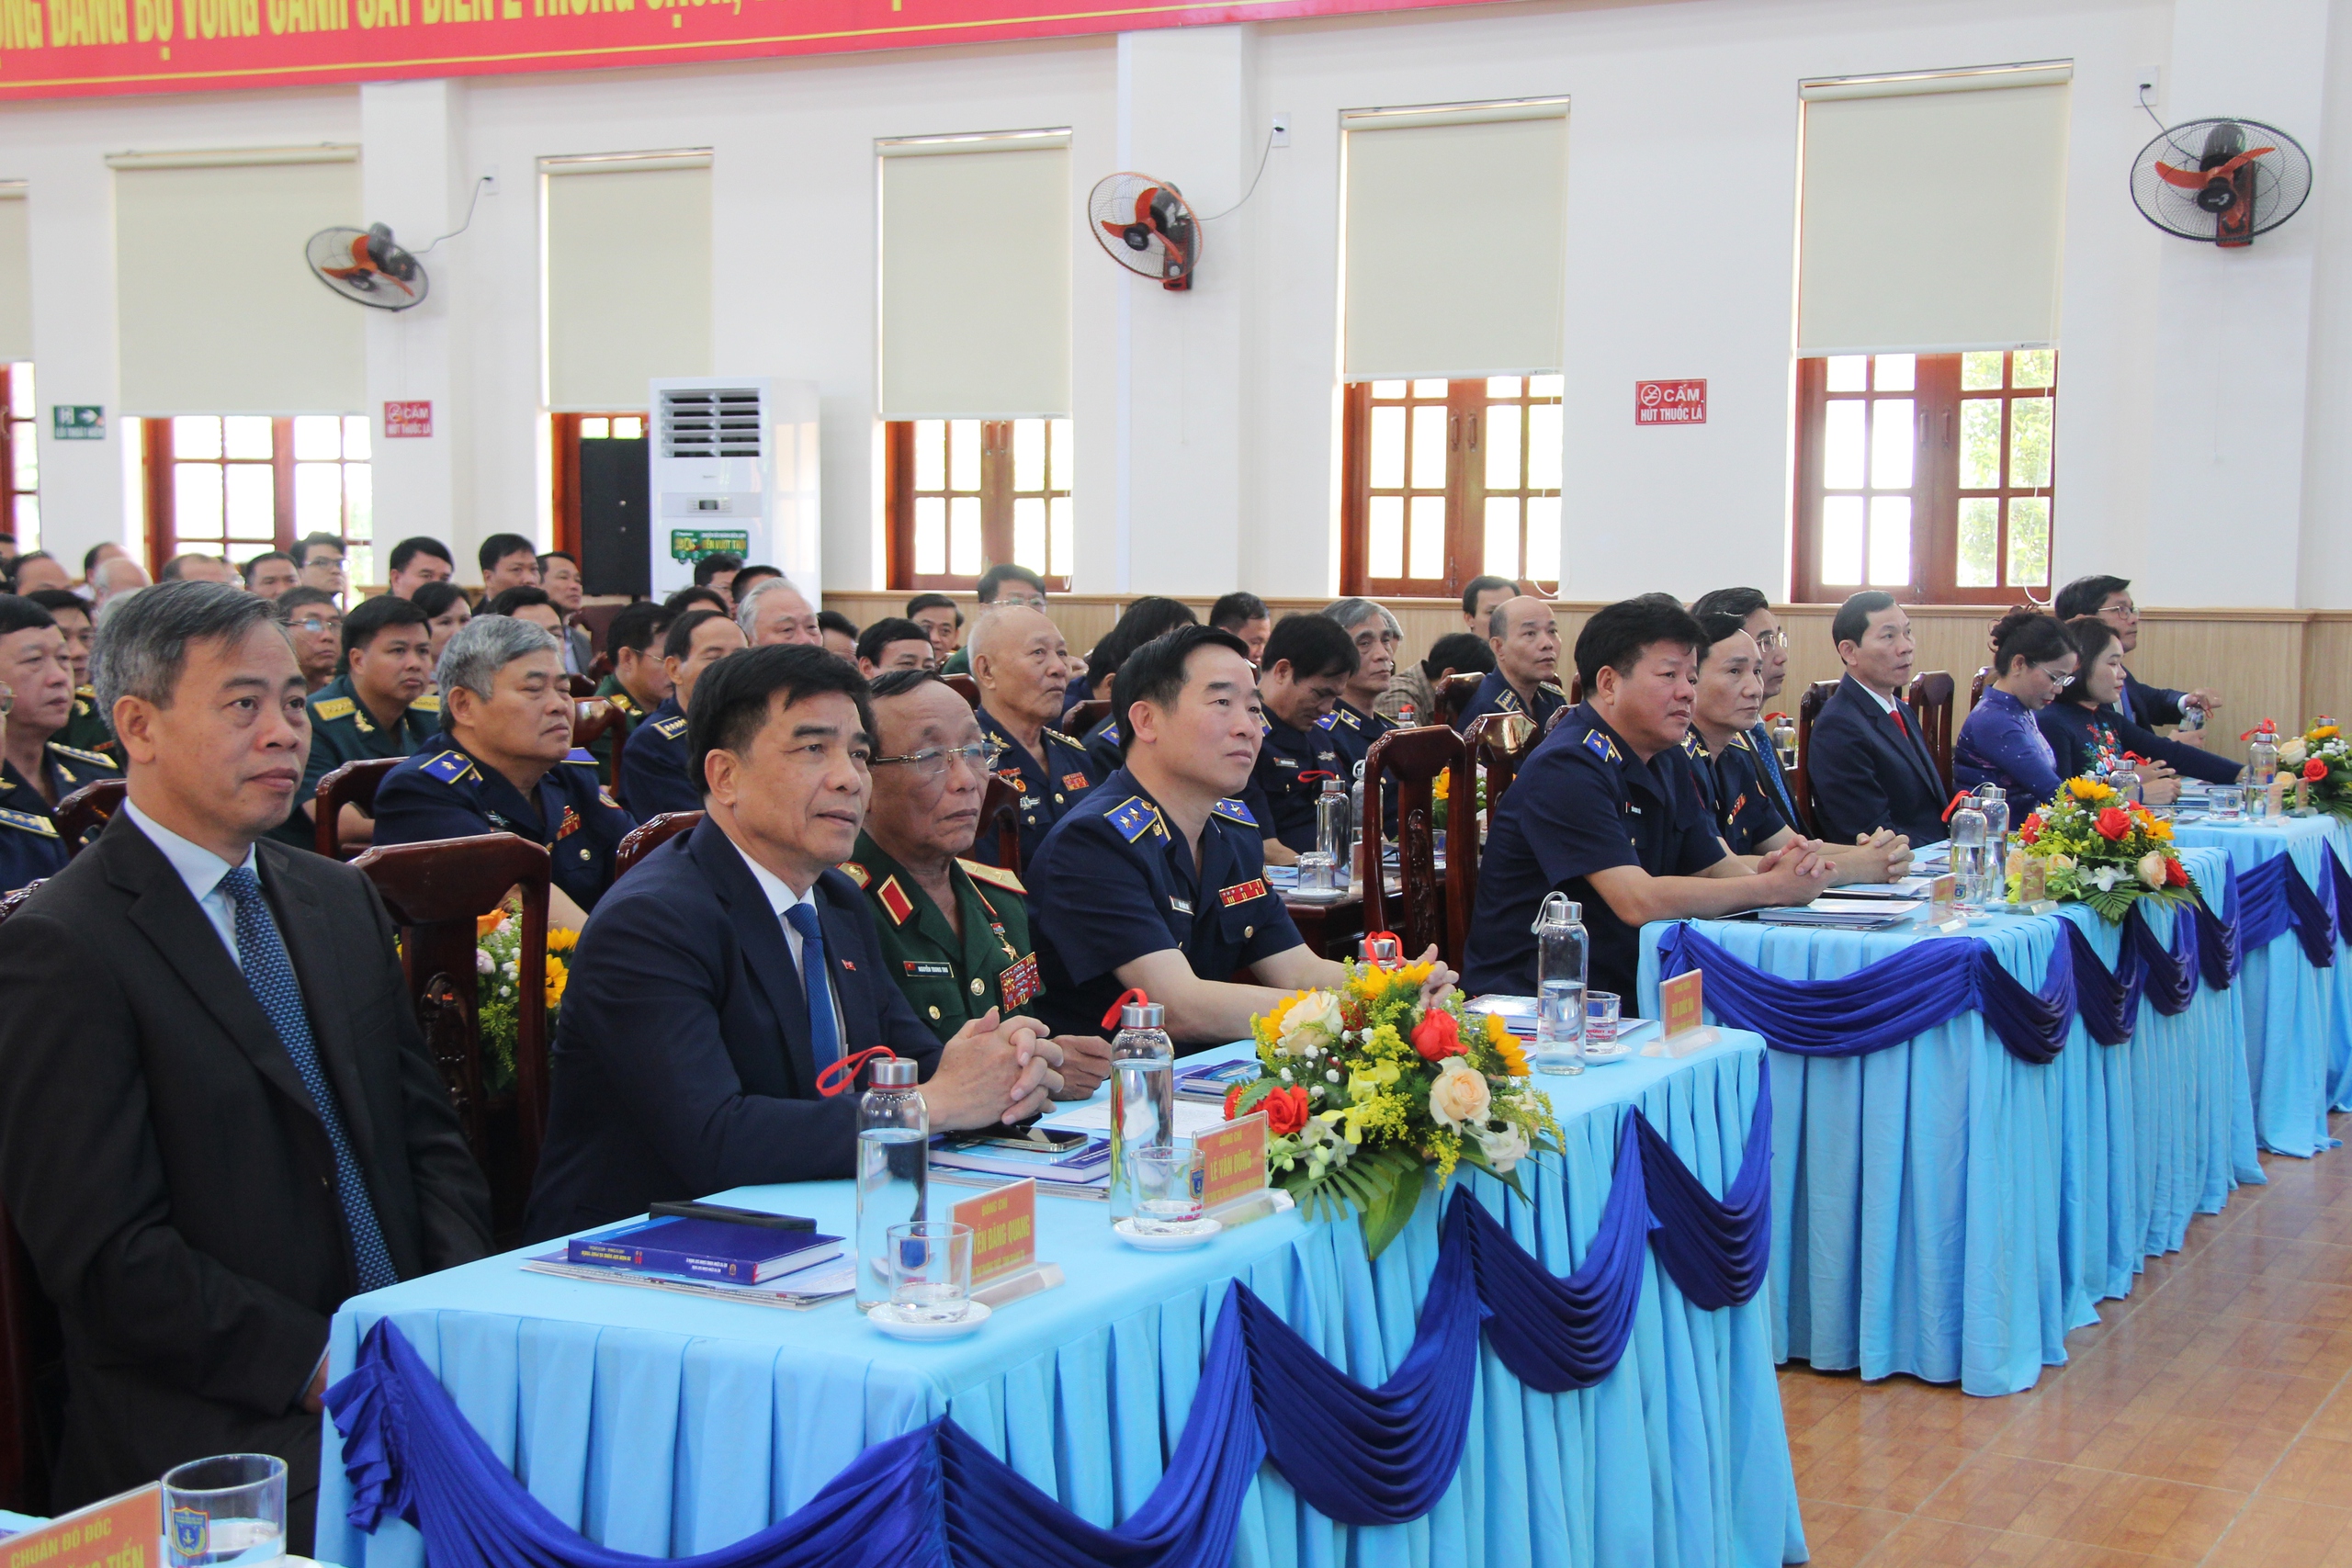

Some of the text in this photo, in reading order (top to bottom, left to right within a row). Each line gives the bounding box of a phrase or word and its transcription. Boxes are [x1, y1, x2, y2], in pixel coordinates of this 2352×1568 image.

[1664, 384, 1700, 402] CẤM
[1641, 403, 1702, 421] HÚT THUỐC LÁ
